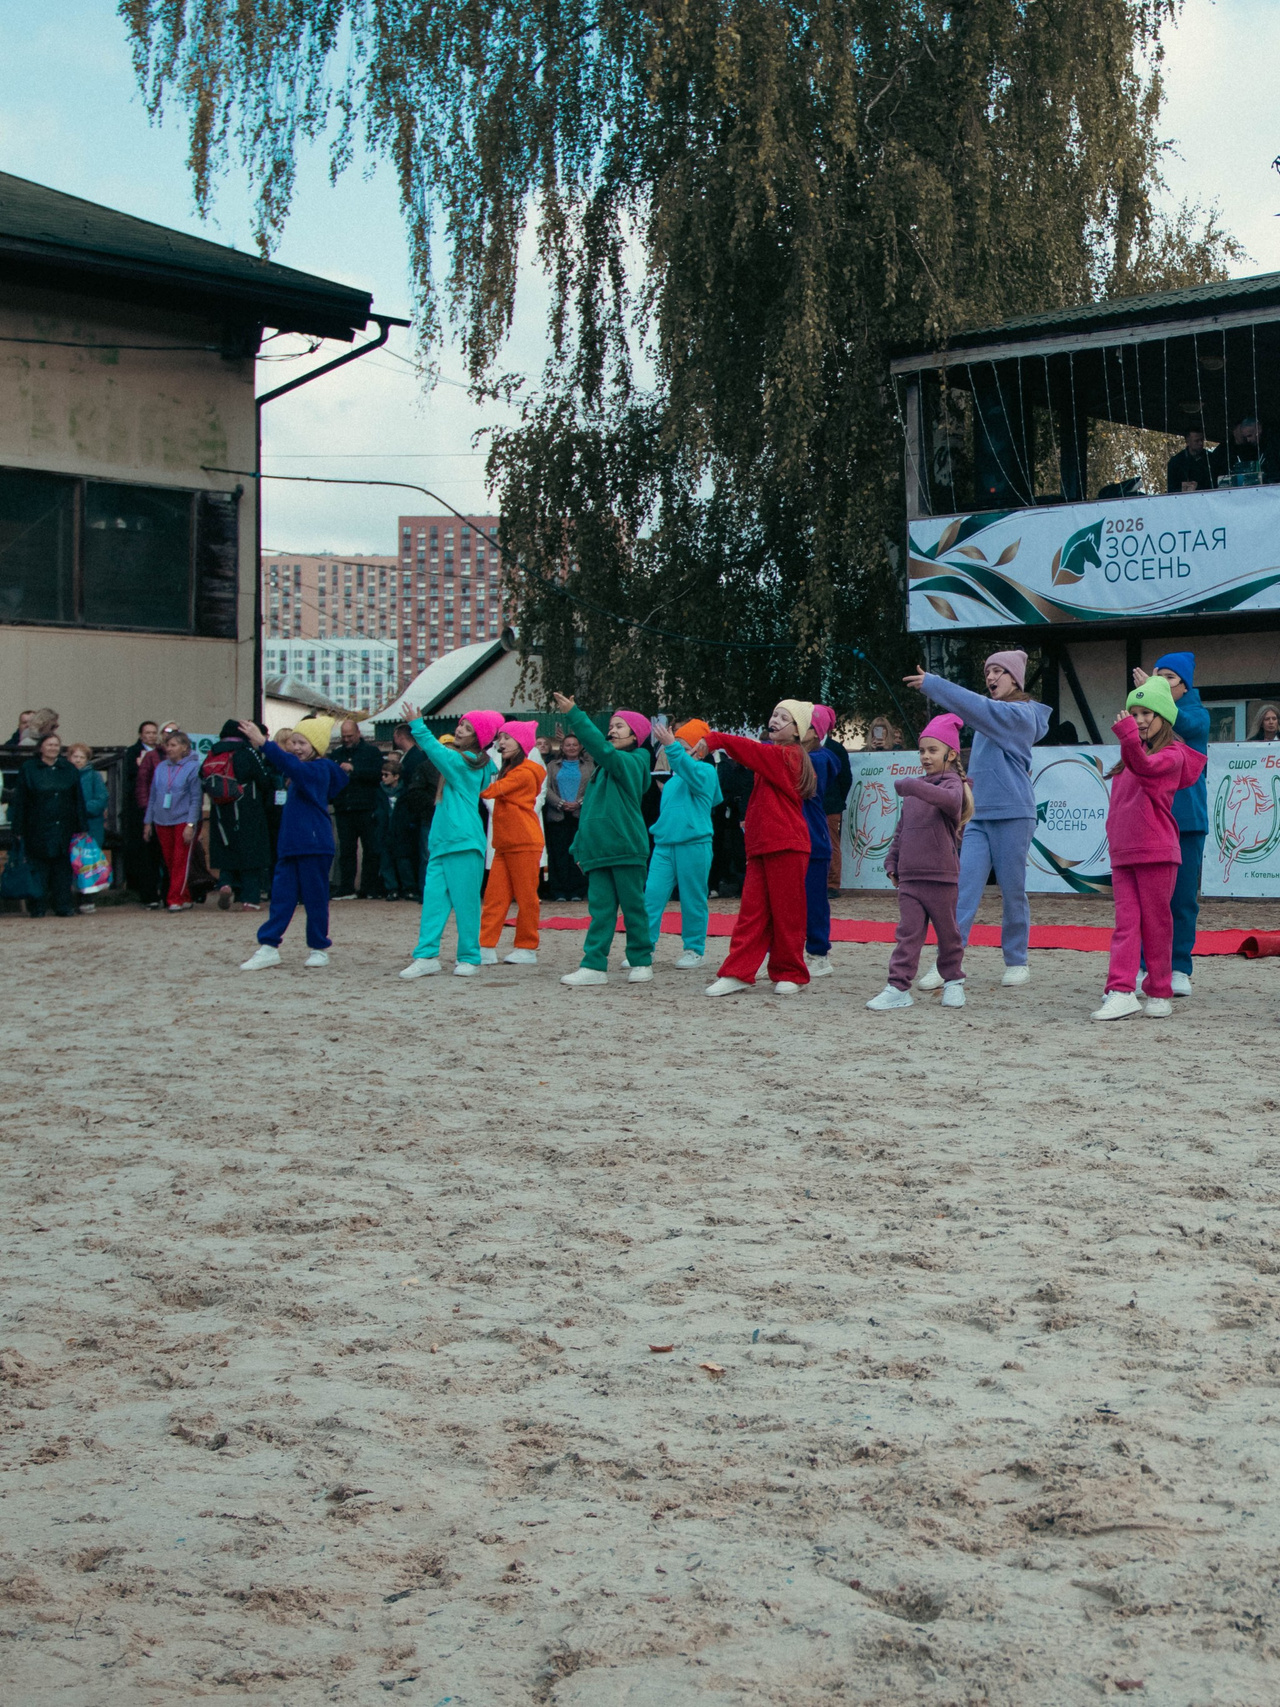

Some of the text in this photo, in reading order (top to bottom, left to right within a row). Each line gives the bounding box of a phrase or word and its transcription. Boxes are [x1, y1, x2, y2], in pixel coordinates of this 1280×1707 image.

[1105, 517, 1144, 534] 2026
[1105, 527, 1226, 559] ЗОЛОТАЯ
[1104, 556, 1191, 583] ОСЕНЬ
[1229, 760, 1257, 769] СШОР
[860, 767, 884, 776] СШОР
[1048, 808, 1105, 820] ЗОЛОТАЯ
[1046, 820, 1088, 831] ОСЕНЬ
